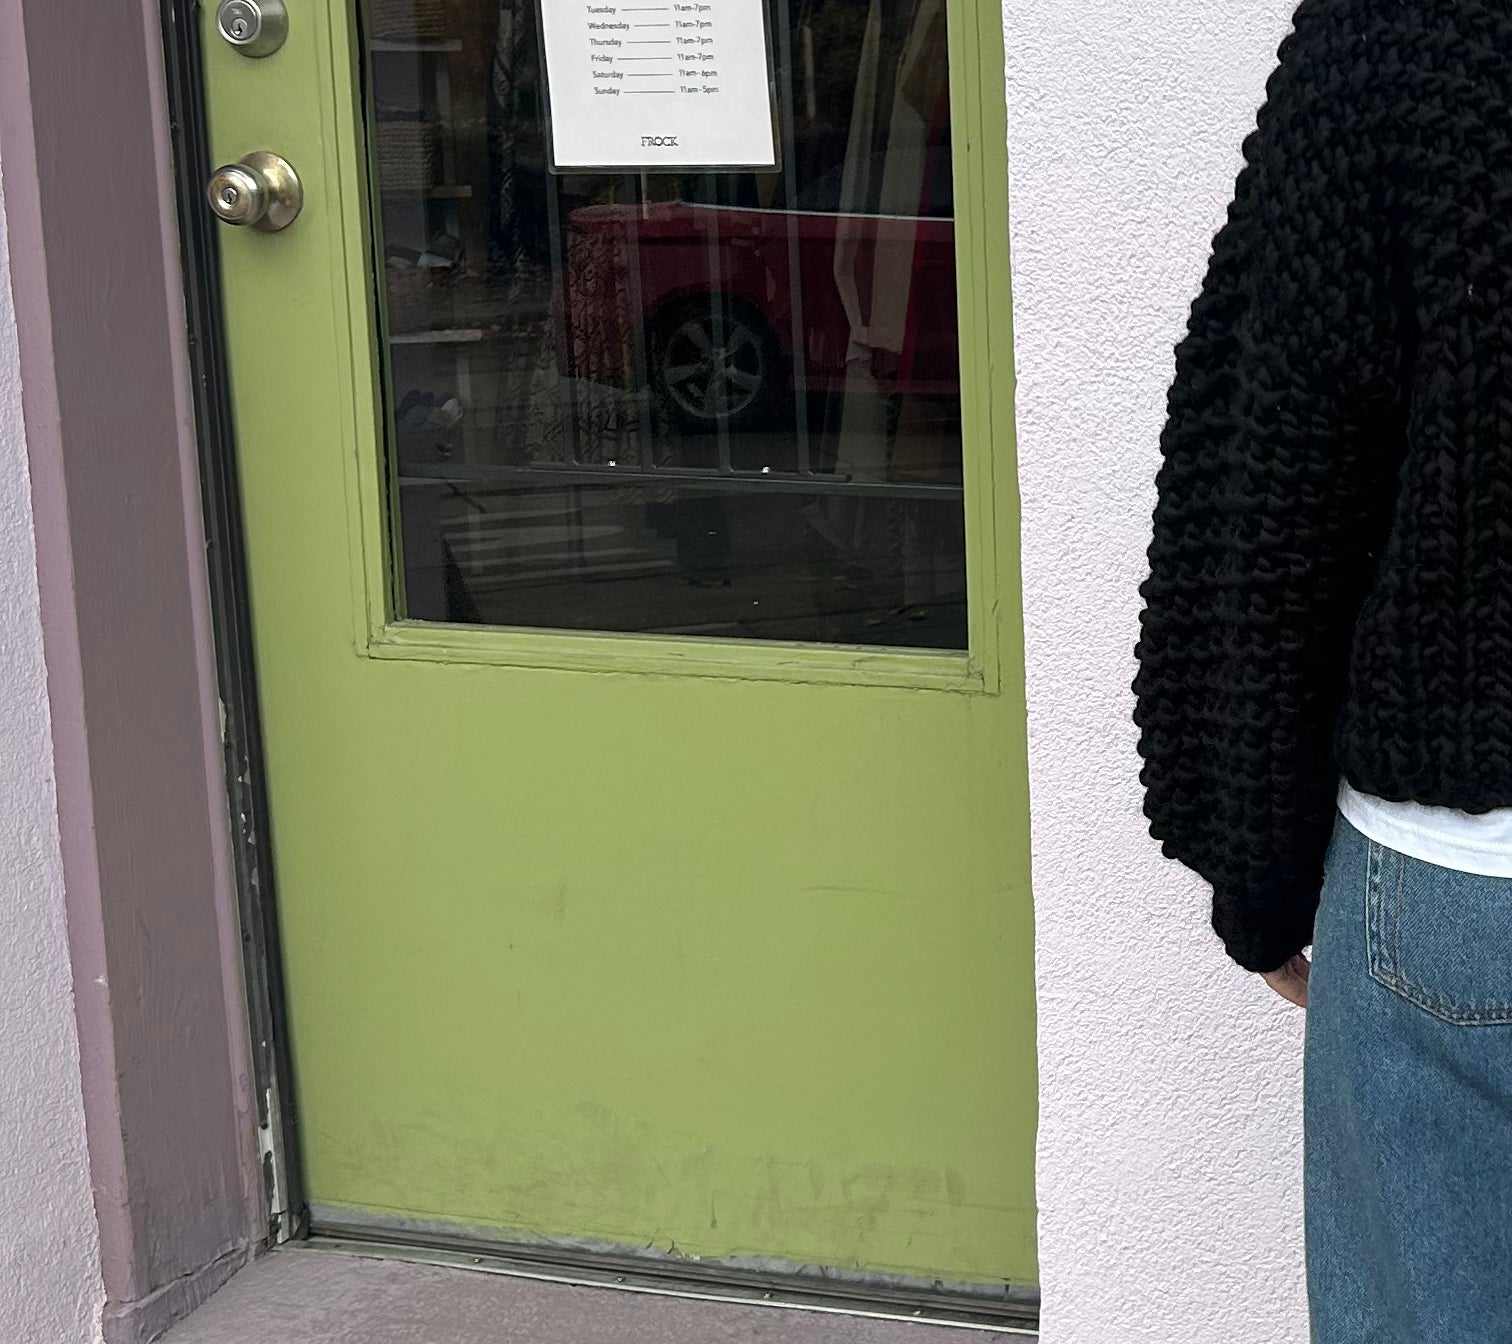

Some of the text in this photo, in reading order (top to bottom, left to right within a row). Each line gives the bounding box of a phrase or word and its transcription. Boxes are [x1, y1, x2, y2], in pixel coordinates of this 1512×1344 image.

[586, 5, 616, 15] Tuesday
[588, 22, 630, 31] Wednesday
[589, 38, 622, 48] Thursday
[591, 54, 614, 64] Friday
[592, 70, 624, 80] Saturday
[594, 86, 620, 96] Sunday
[641, 136, 679, 147] FROCK
